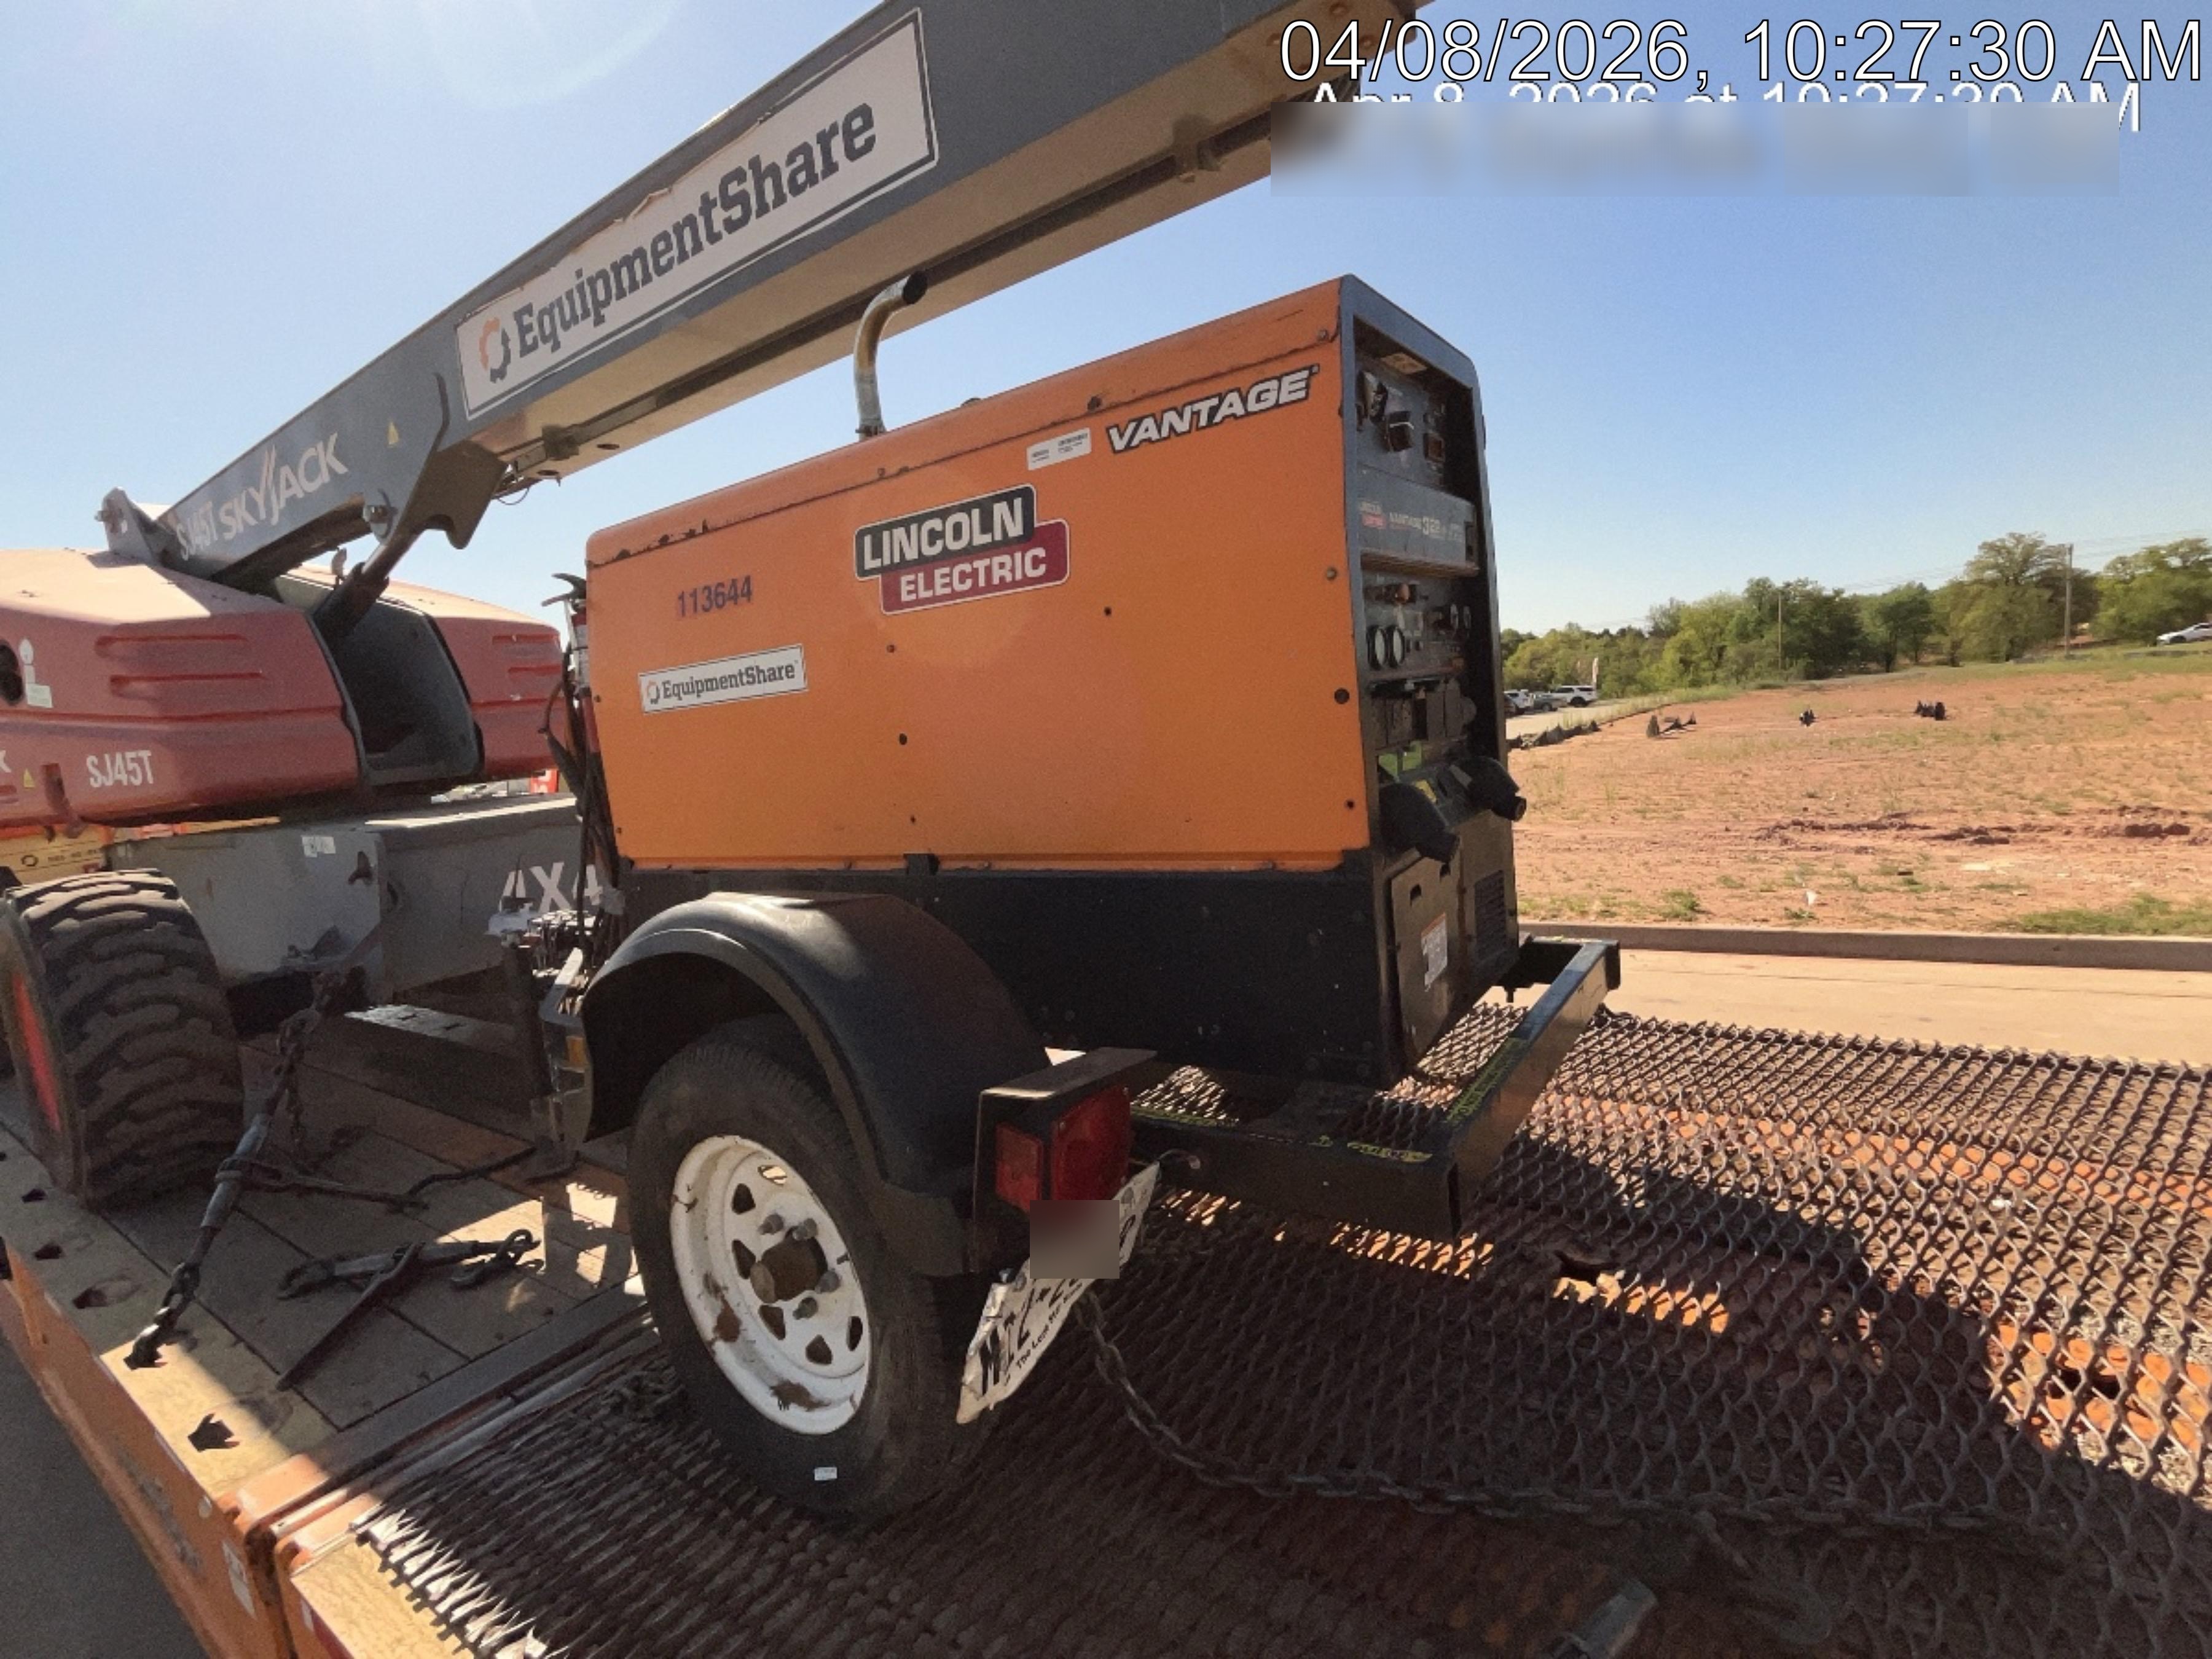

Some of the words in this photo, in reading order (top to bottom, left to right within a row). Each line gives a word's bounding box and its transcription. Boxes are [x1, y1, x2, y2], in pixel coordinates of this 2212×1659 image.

[513, 103, 876, 358] EquipmentShare
[1107, 369, 1311, 453] VANTAGE
[219, 431, 349, 526] SKYJACK
[863, 497, 1024, 570] LINCOLN
[678, 575, 753, 618] 113644
[900, 547, 1046, 602] ELECTRIC
[662, 662, 795, 700] EquipmentShare
[86, 750, 154, 788] SJ45T
